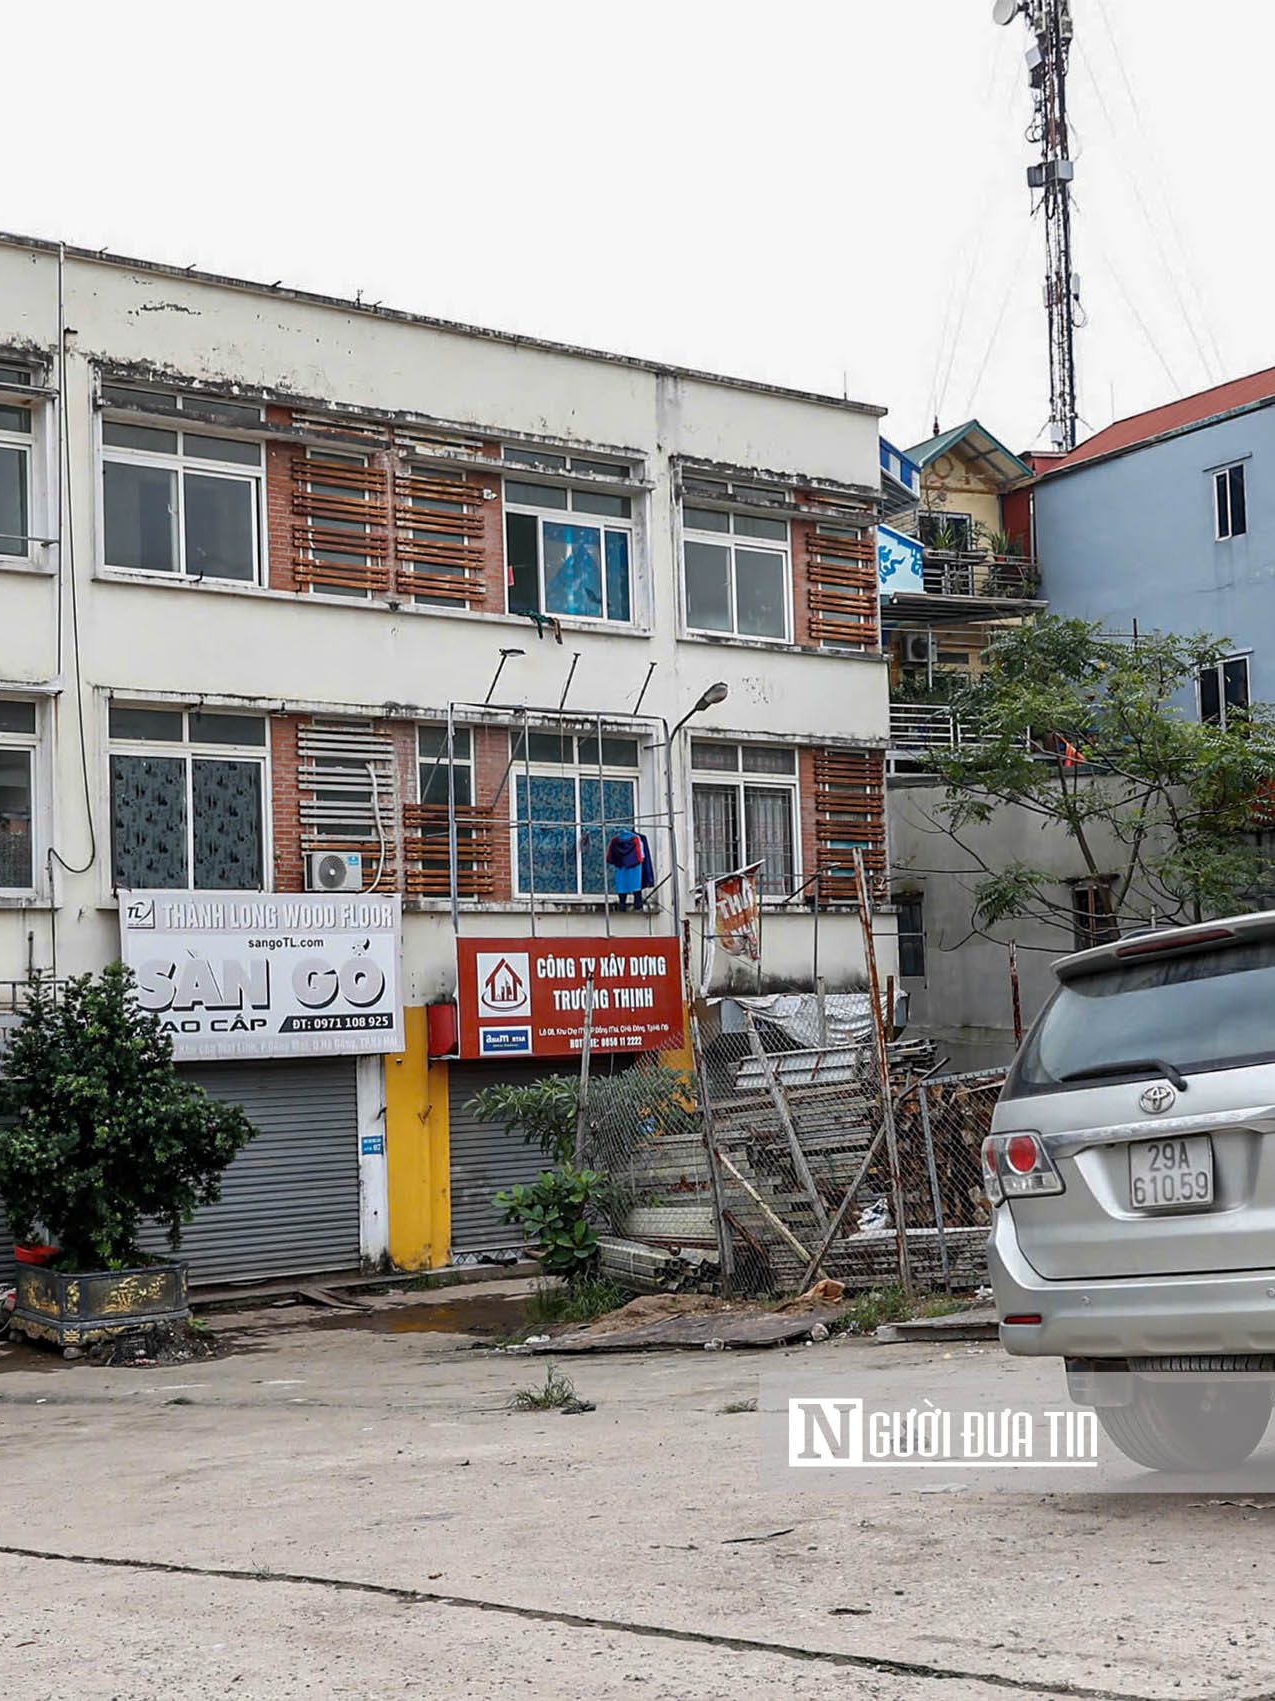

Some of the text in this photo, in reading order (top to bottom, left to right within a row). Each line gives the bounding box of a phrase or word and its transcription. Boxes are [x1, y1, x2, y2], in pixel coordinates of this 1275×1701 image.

[164, 899, 393, 929] THÀNH LONG WOOD FLOOR
[248, 937, 324, 950] sangoTL.com
[536, 952, 667, 981] CÔNG TY XÂY DỰNG
[135, 949, 271, 1013] SÀN
[613, 987, 654, 1012] THỊNH
[160, 1013, 267, 1033] AO CẤP
[292, 1015, 389, 1030] ĐT: 0971 108 925
[627, 1035, 642, 1046] 2222
[1148, 1141, 1190, 1172] 29A
[1133, 1171, 1209, 1205] 610.59
